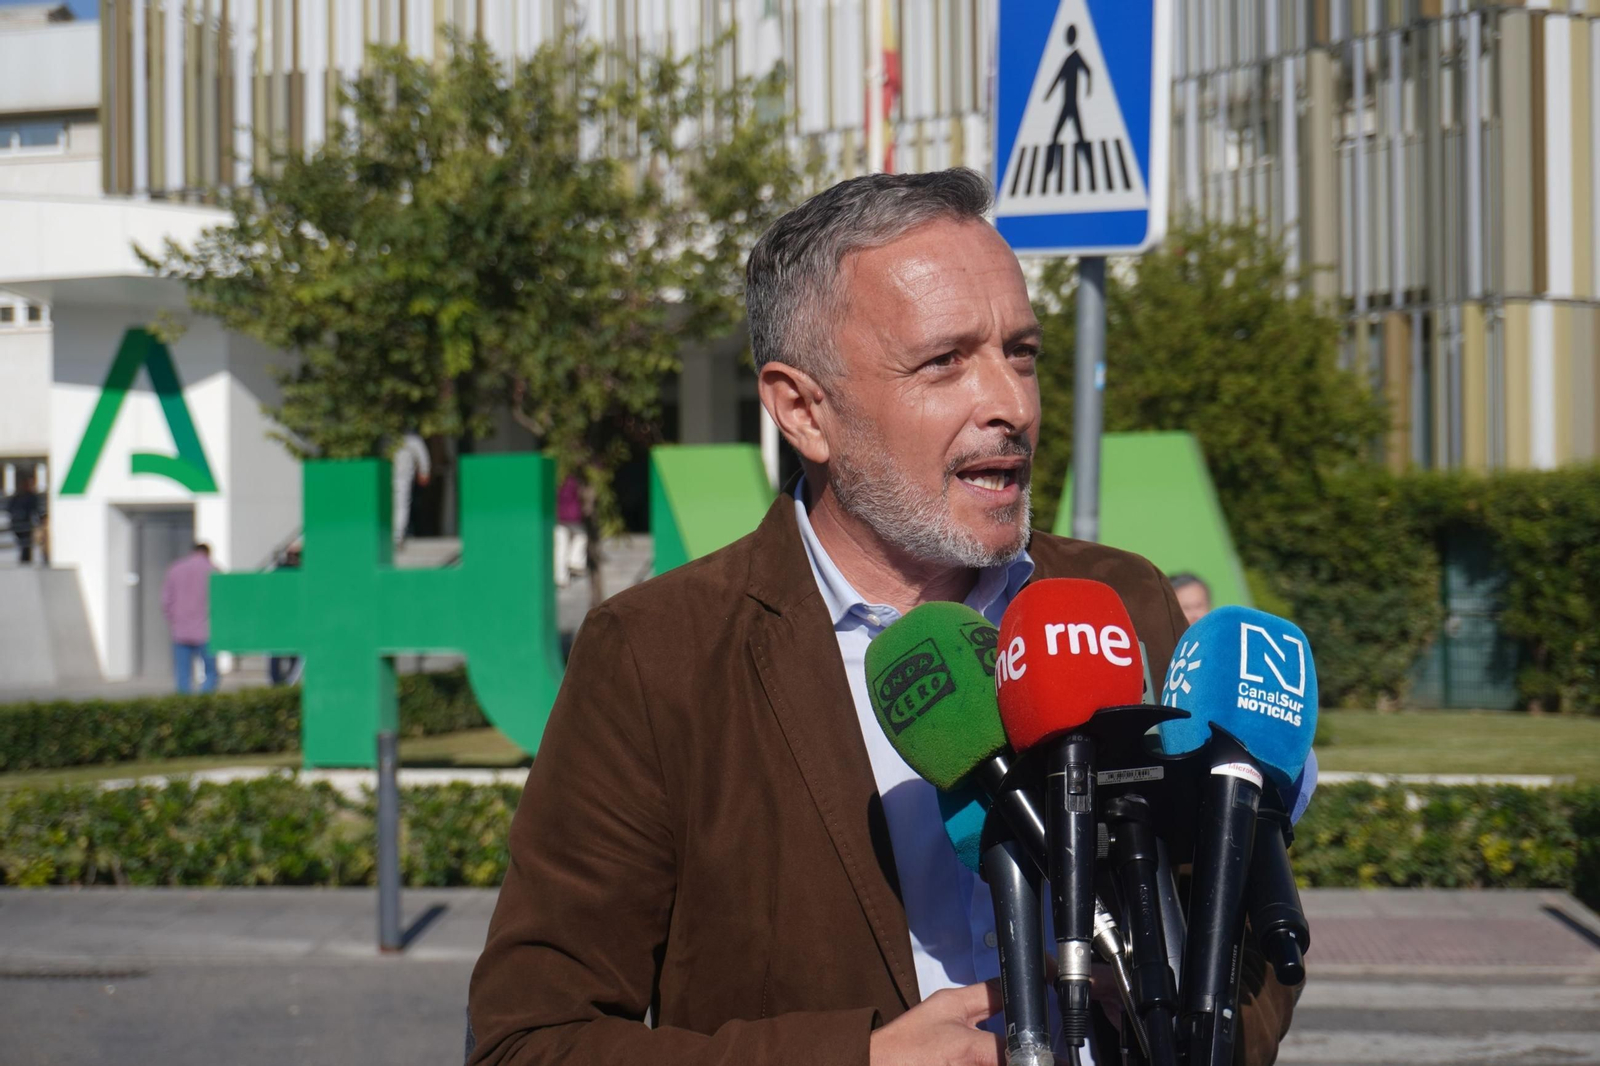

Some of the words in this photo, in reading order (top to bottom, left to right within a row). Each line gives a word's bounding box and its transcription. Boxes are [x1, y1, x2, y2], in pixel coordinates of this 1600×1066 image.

[1044, 622, 1133, 667] rne
[881, 657, 931, 697] ONDA
[994, 636, 1027, 697] ne
[893, 675, 942, 718] CERO
[1237, 696, 1303, 728] NOTICIAS
[1229, 944, 1239, 985] SENNHEISER
